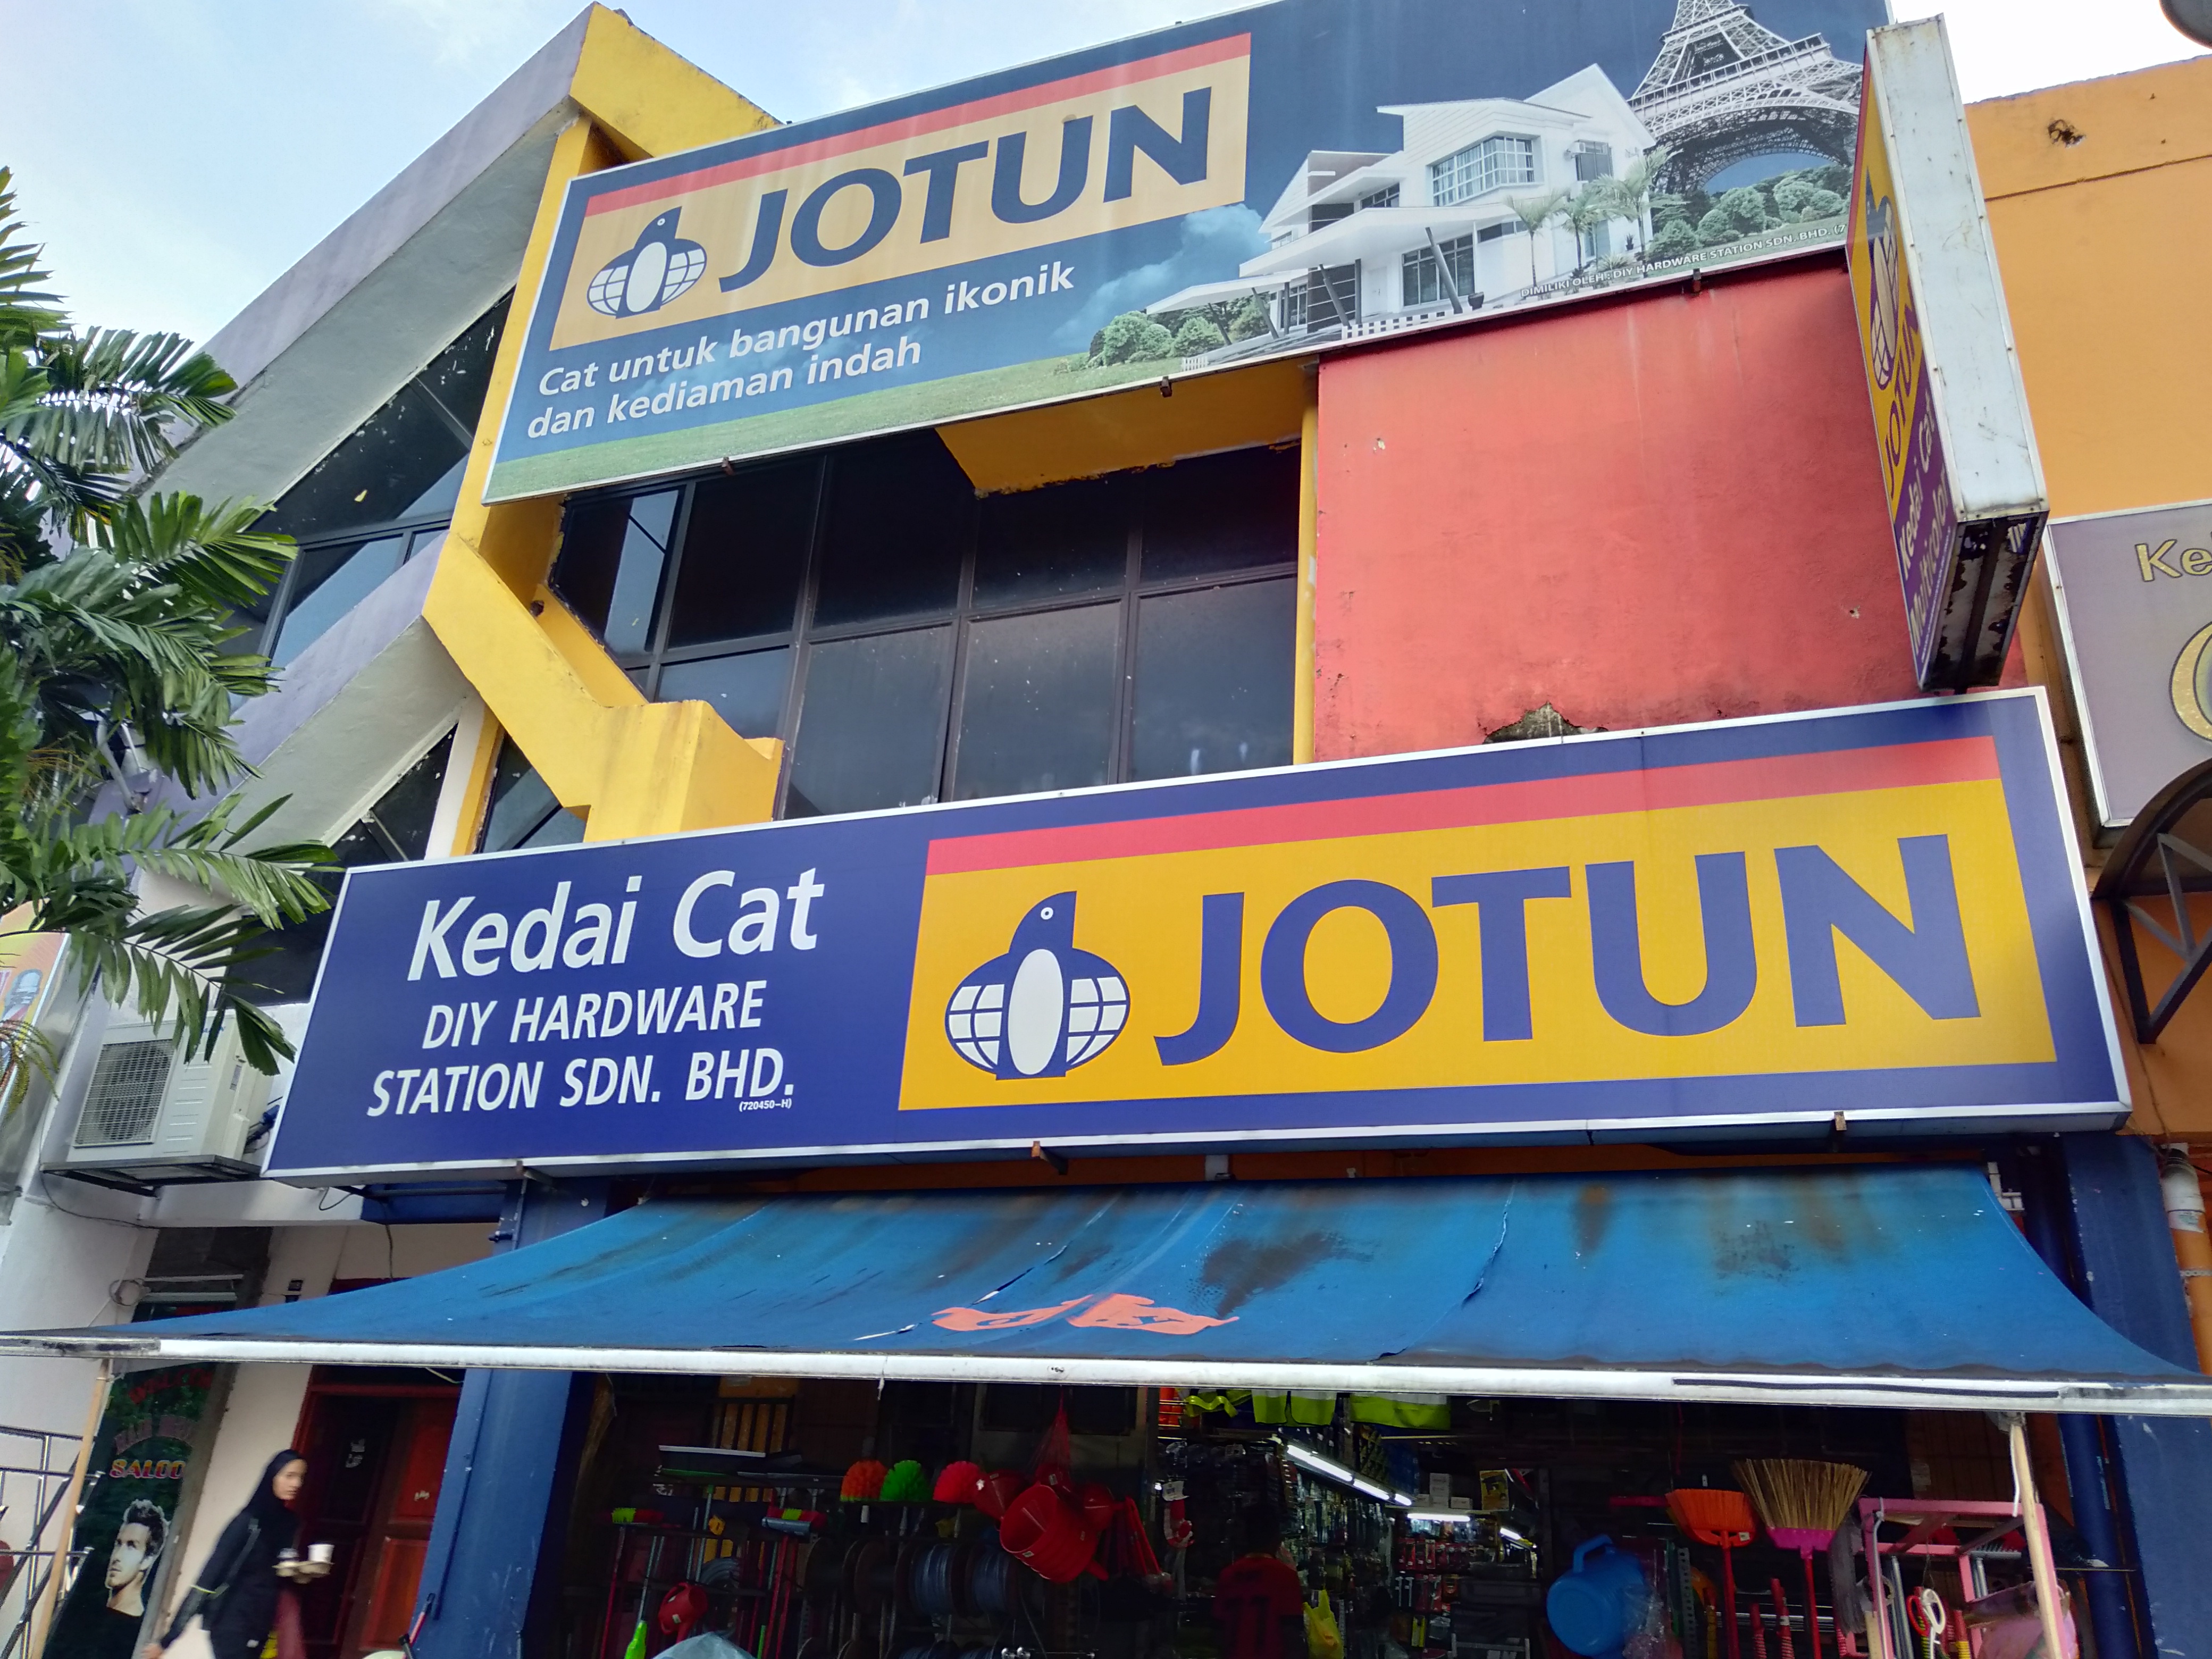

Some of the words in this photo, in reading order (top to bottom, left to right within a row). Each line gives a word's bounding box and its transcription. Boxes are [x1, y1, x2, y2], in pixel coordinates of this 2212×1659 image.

[719, 86, 1212, 293] JOTUN
[1521, 280, 1569, 297] DIMILIKI
[1613, 266, 1633, 278] DIY
[1636, 252, 1707, 273] HARDWARE
[1710, 241, 1763, 259] STATION
[1765, 234, 1797, 248] SDN.
[1799, 228, 1831, 241] BHD.
[539, 362, 599, 396] Cat
[609, 336, 718, 383] untuk
[729, 296, 929, 358] bangunan
[944, 261, 1075, 314] ikonik
[527, 407, 595, 439] dan
[607, 366, 794, 424] kediaman
[807, 337, 921, 384] indah
[1899, 455, 1924, 582] Kedai
[1918, 388, 1936, 474] Cat
[1909, 460, 1949, 656] Multicolor
[2134, 532, 2212, 583] Ke
[407, 874, 643, 982] Kedai
[673, 867, 825, 958] Cat
[1154, 833, 1982, 1066] JOTUN
[422, 1001, 498, 1049] DIY
[509, 980, 767, 1043] HARDWARE
[366, 1061, 544, 1116] STATION
[559, 1054, 661, 1107] SDN.
[685, 1048, 794, 1100] BHD.
[739, 1097, 792, 1112] (720450-H)
